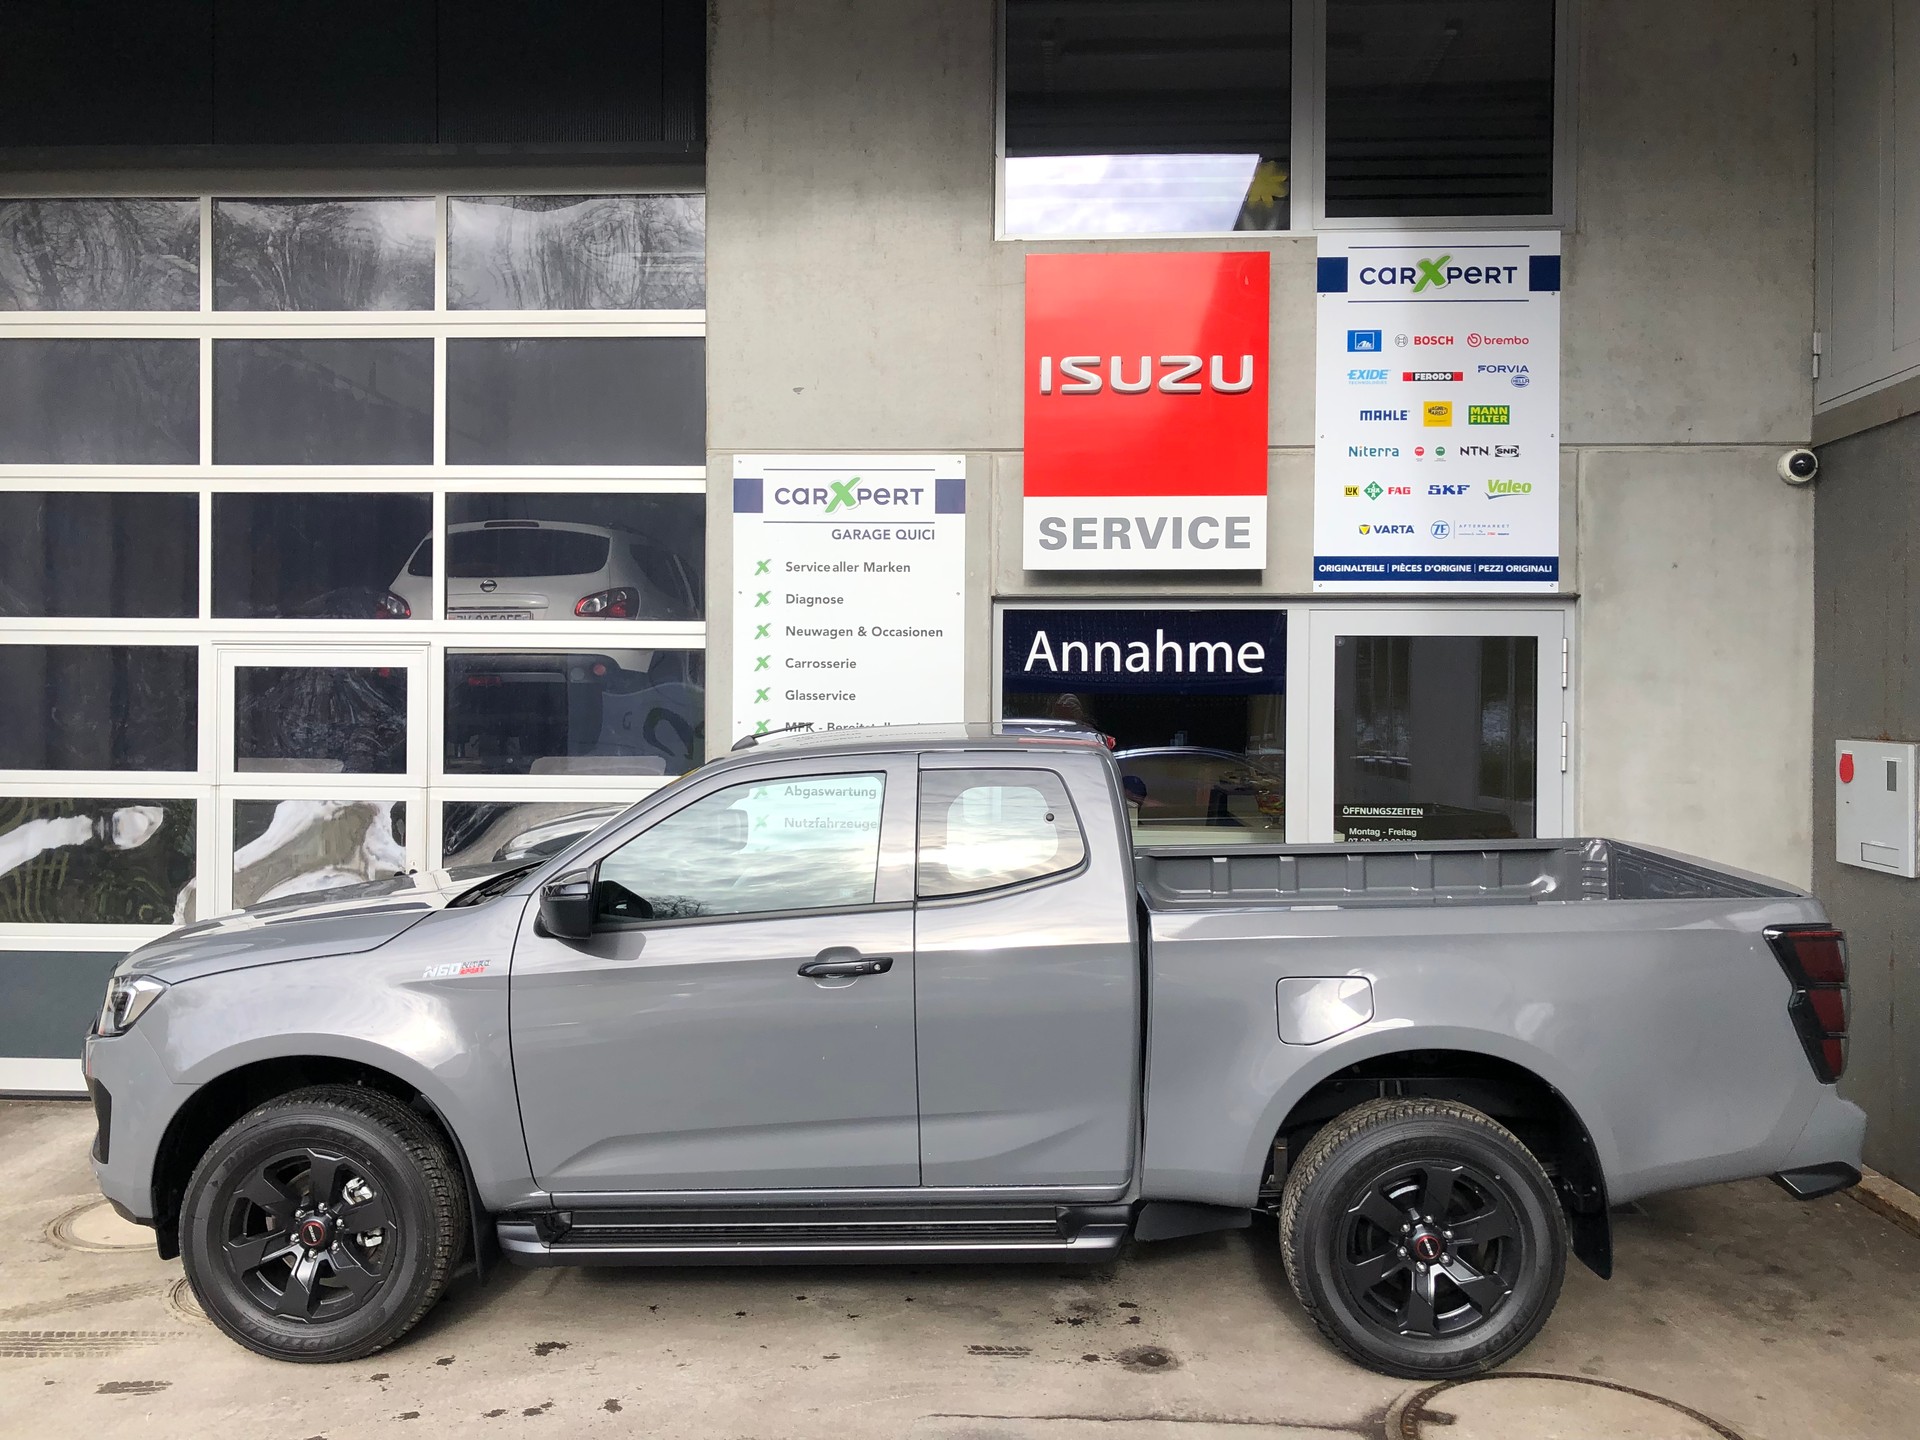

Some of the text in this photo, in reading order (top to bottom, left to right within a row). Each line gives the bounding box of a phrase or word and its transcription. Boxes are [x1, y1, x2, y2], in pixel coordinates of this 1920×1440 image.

[1414, 335, 1454, 346] BOSCH
[1483, 335, 1530, 346] brembo
[1477, 364, 1529, 373] FORVIA
[1040, 355, 1254, 395] ISUZU
[1347, 369, 1389, 380] EXIDE
[1414, 372, 1452, 381] FERODO
[1512, 377, 1530, 385] HELLA
[1360, 410, 1408, 421] MAHLE
[1470, 405, 1509, 415] MANN
[1470, 414, 1509, 424] FILTER
[1348, 446, 1400, 457] Niterra
[1459, 446, 1489, 456] NTN
[1496, 447, 1518, 456] SNR
[1388, 486, 1411, 495] FAG
[1427, 485, 1471, 495] SKF
[1487, 479, 1532, 494] Valeo
[831, 529, 935, 541] GARAGE QUICI
[1039, 516, 1251, 550] SERVICE
[1373, 524, 1415, 535] VARTA
[785, 561, 911, 573] Service aller Marken
[1318, 564, 1385, 573] ORIGINALTEILE
[1391, 562, 1422, 573] PIÈCES
[1478, 564, 1504, 573] PEZZI
[1505, 564, 1553, 573] ORIGINALI
[785, 593, 844, 607] Diagnose
[785, 625, 943, 639] Neuwagen & Occasionen
[1024, 629, 1266, 673] Annahme
[785, 657, 857, 669] Carrosserie
[785, 689, 856, 701] Glasservice
[784, 785, 877, 799] Abgaswartung
[1342, 806, 1423, 815] ÖFFNUNGSZEITEN
[784, 818, 877, 831] Nutzfahrzeuge
[1349, 828, 1380, 837] Montag
[1388, 828, 1417, 837] Freitag
